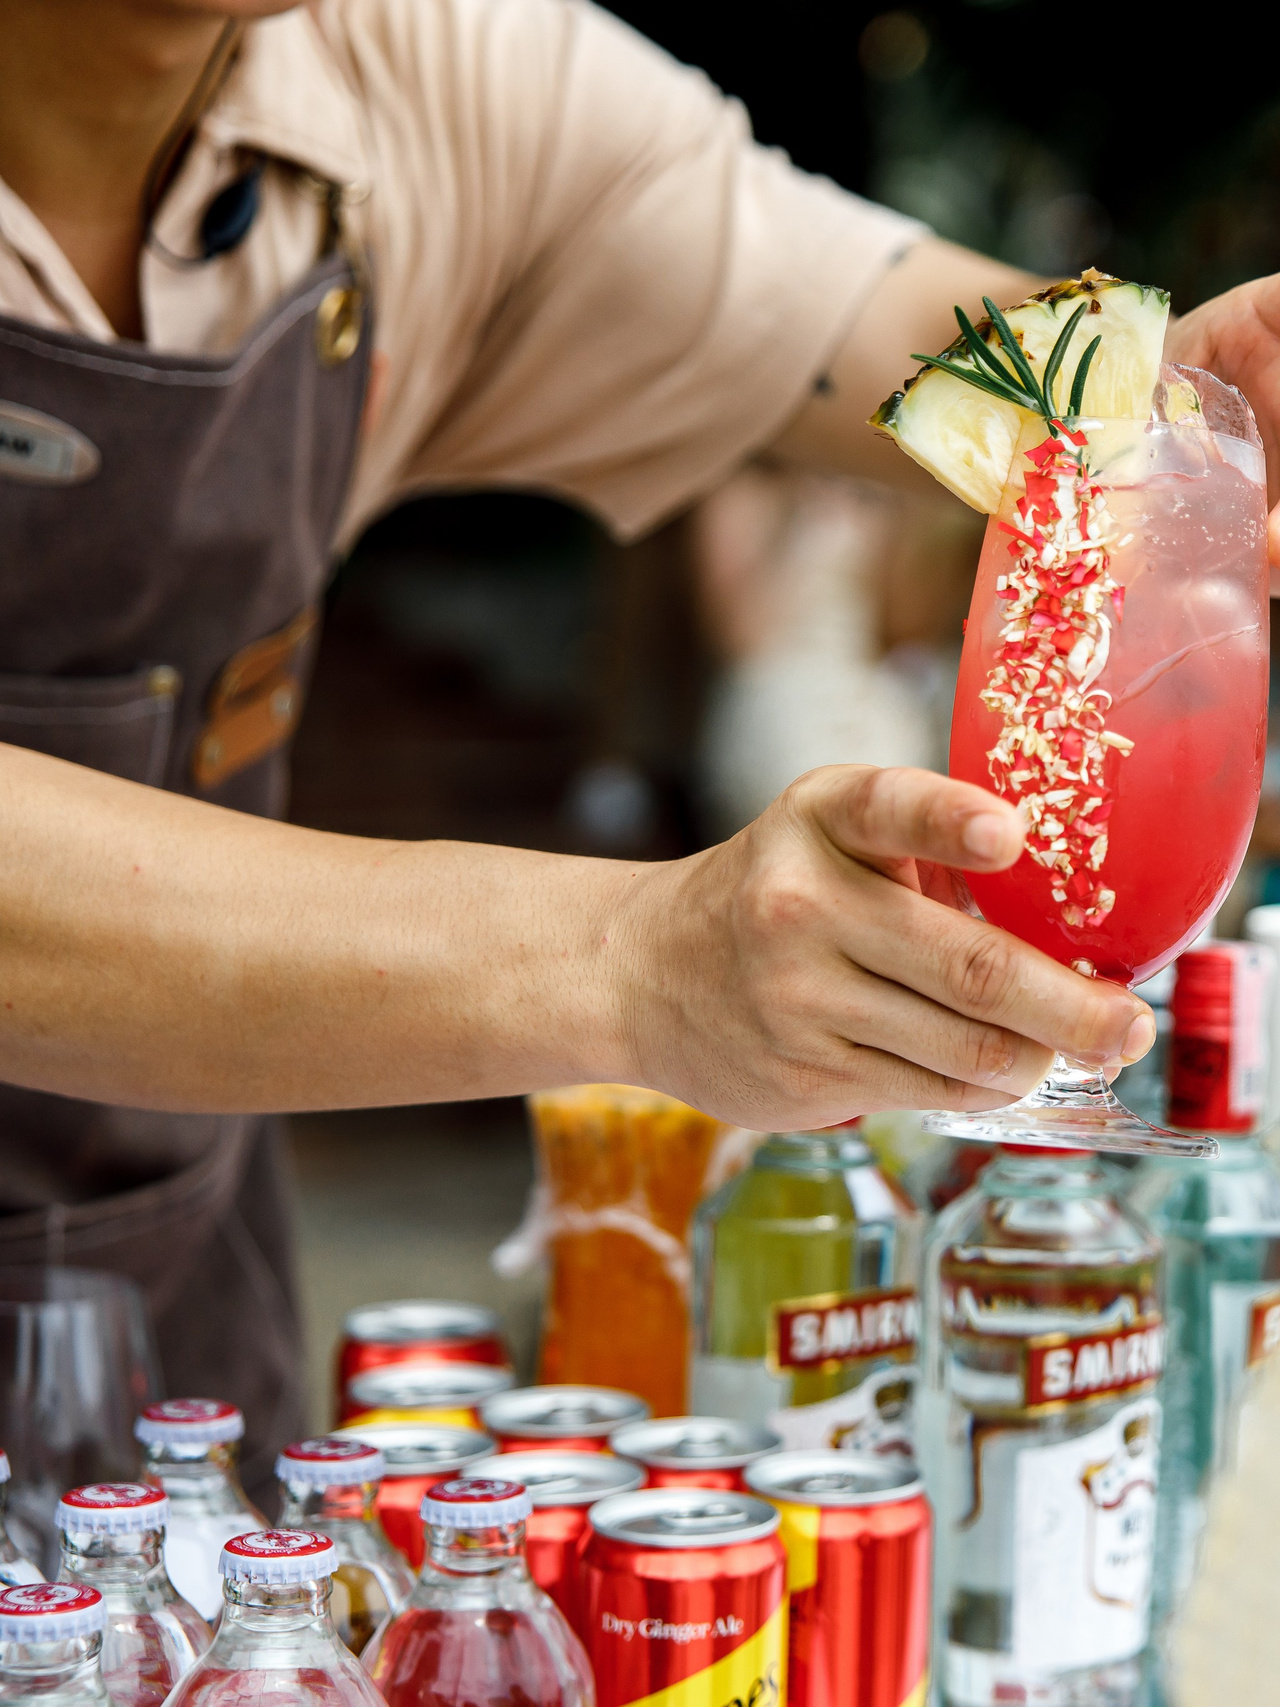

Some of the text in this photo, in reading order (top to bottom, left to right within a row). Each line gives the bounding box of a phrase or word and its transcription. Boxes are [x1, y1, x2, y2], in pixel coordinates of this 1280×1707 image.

[602, 1611, 744, 1645] Dry Ginger Ale
